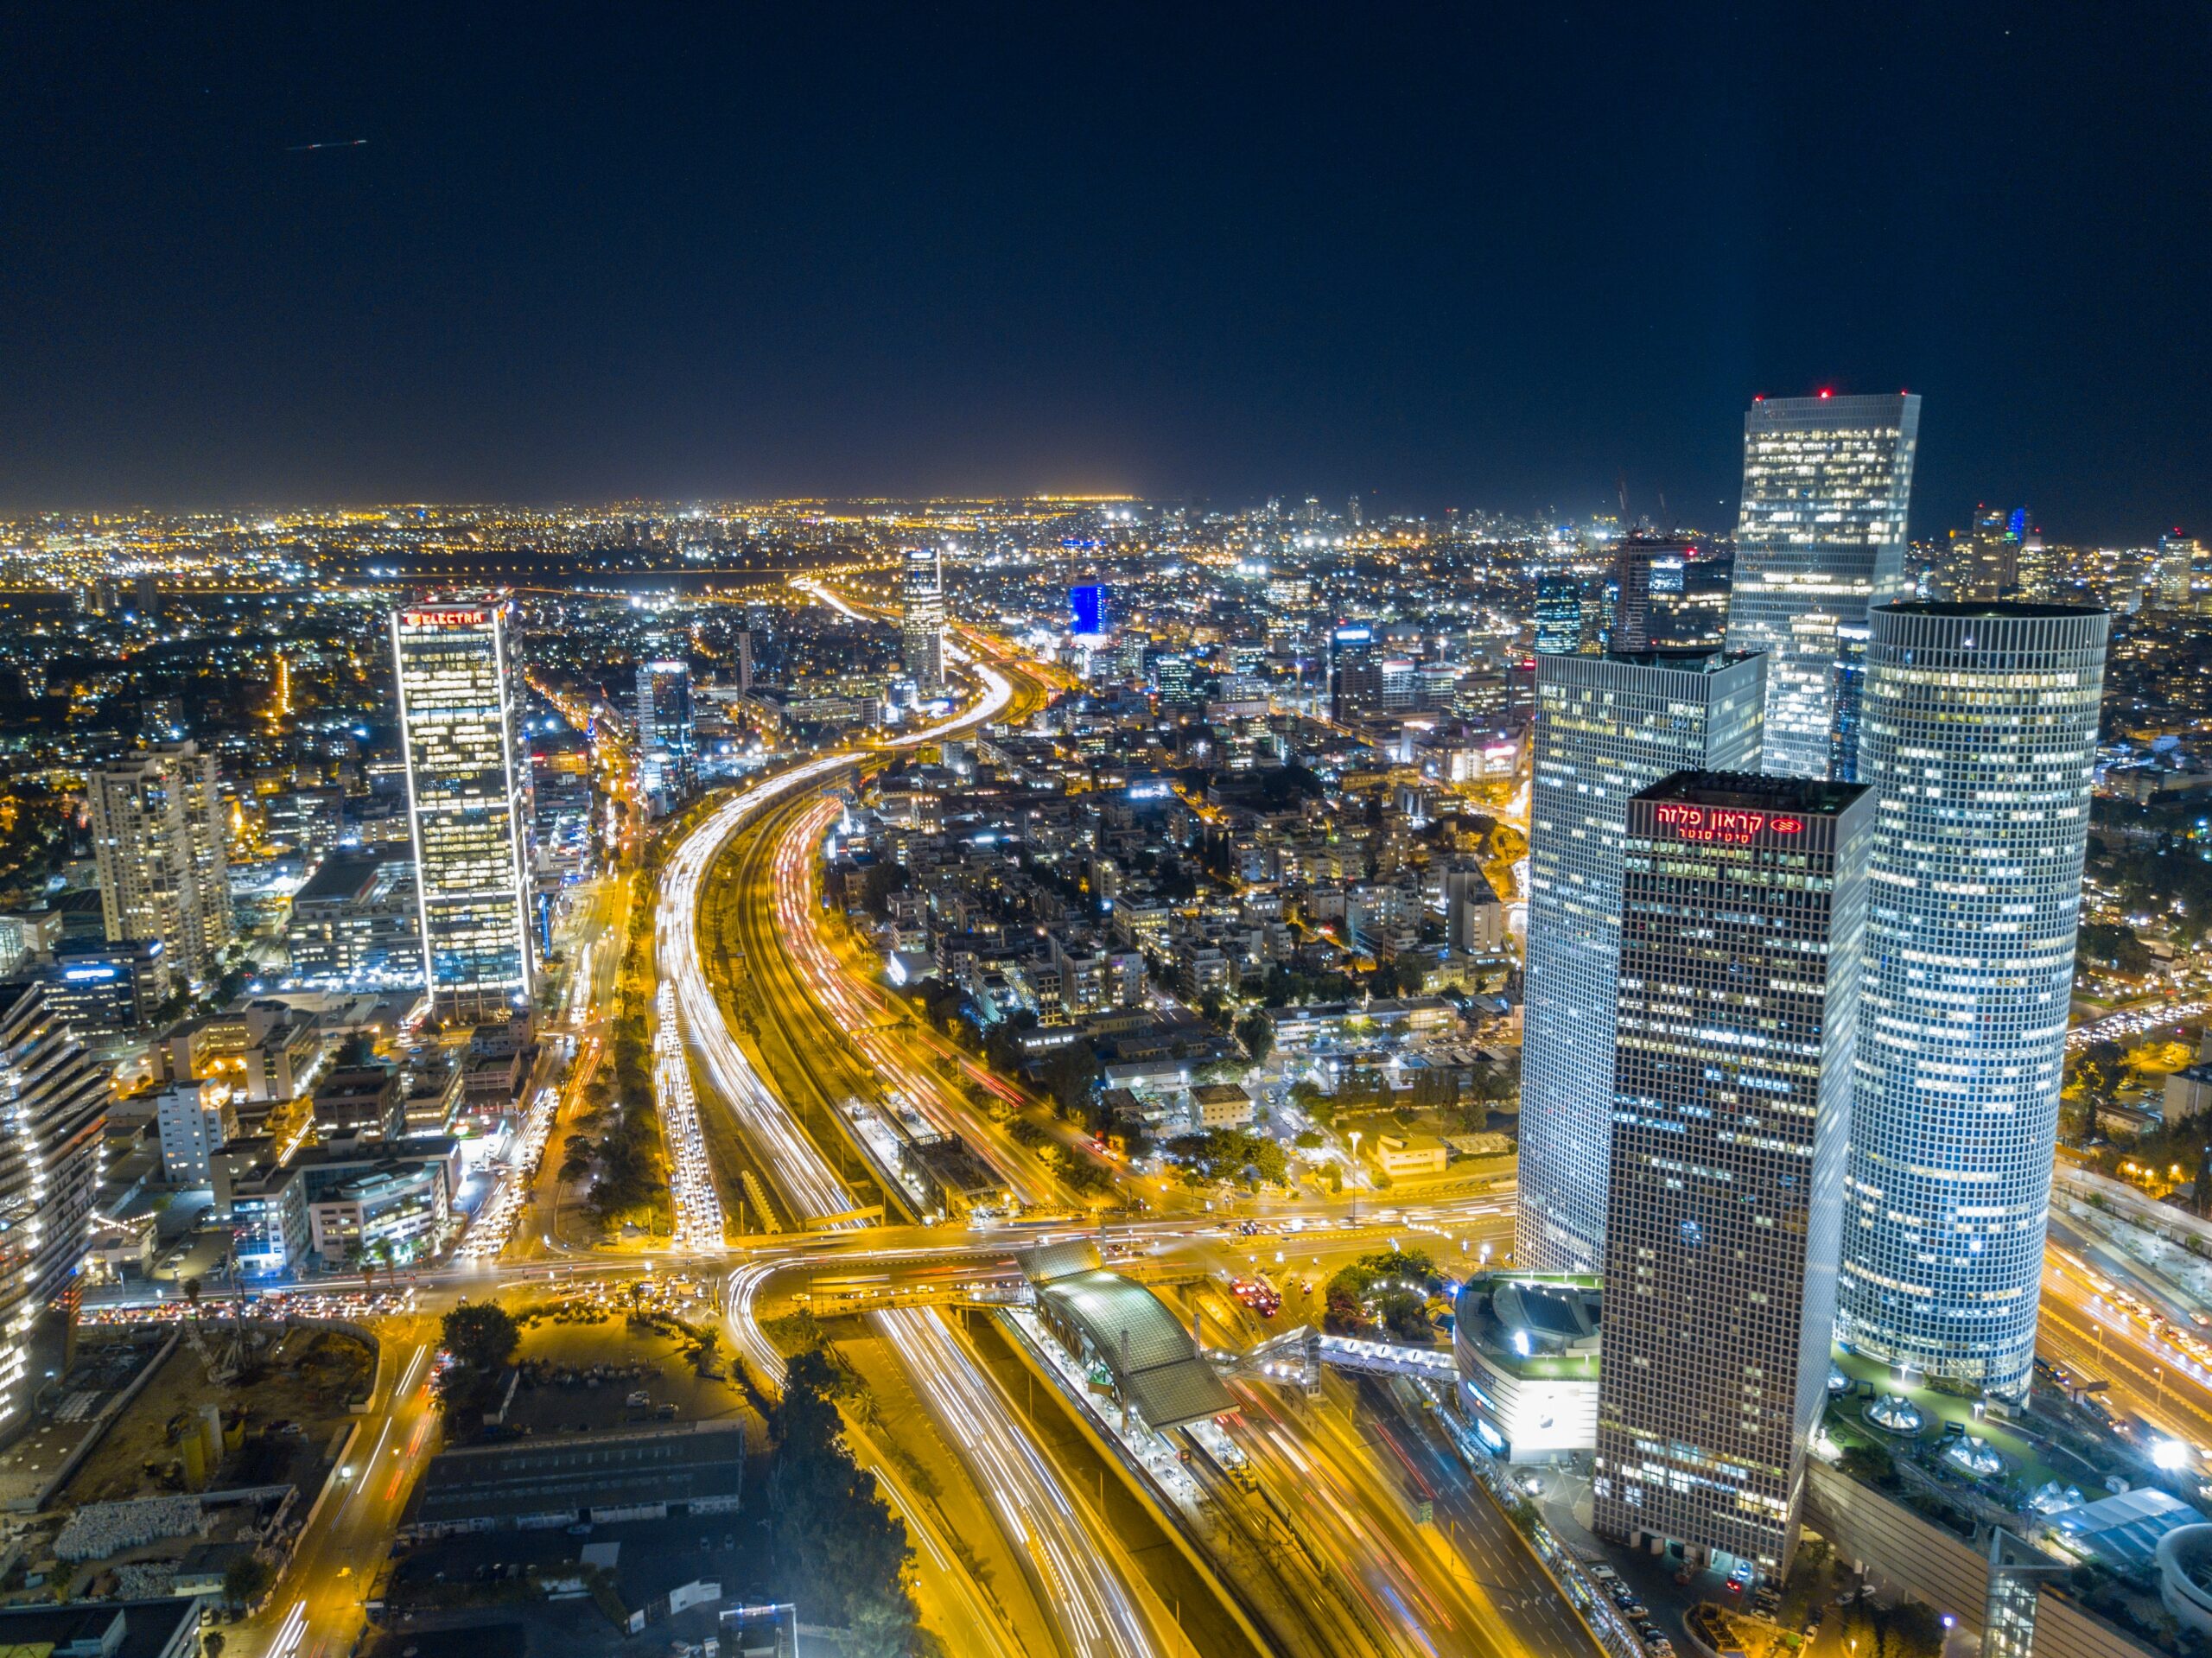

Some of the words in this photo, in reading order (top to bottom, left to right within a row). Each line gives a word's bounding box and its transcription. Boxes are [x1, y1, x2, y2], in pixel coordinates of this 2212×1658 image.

[422, 613, 482, 625] ELECTRA
[1658, 806, 1701, 825] פלזה
[1711, 811, 1763, 834] קראון
[1679, 829, 1713, 840] סנטר
[1718, 832, 1749, 844] סיטי
